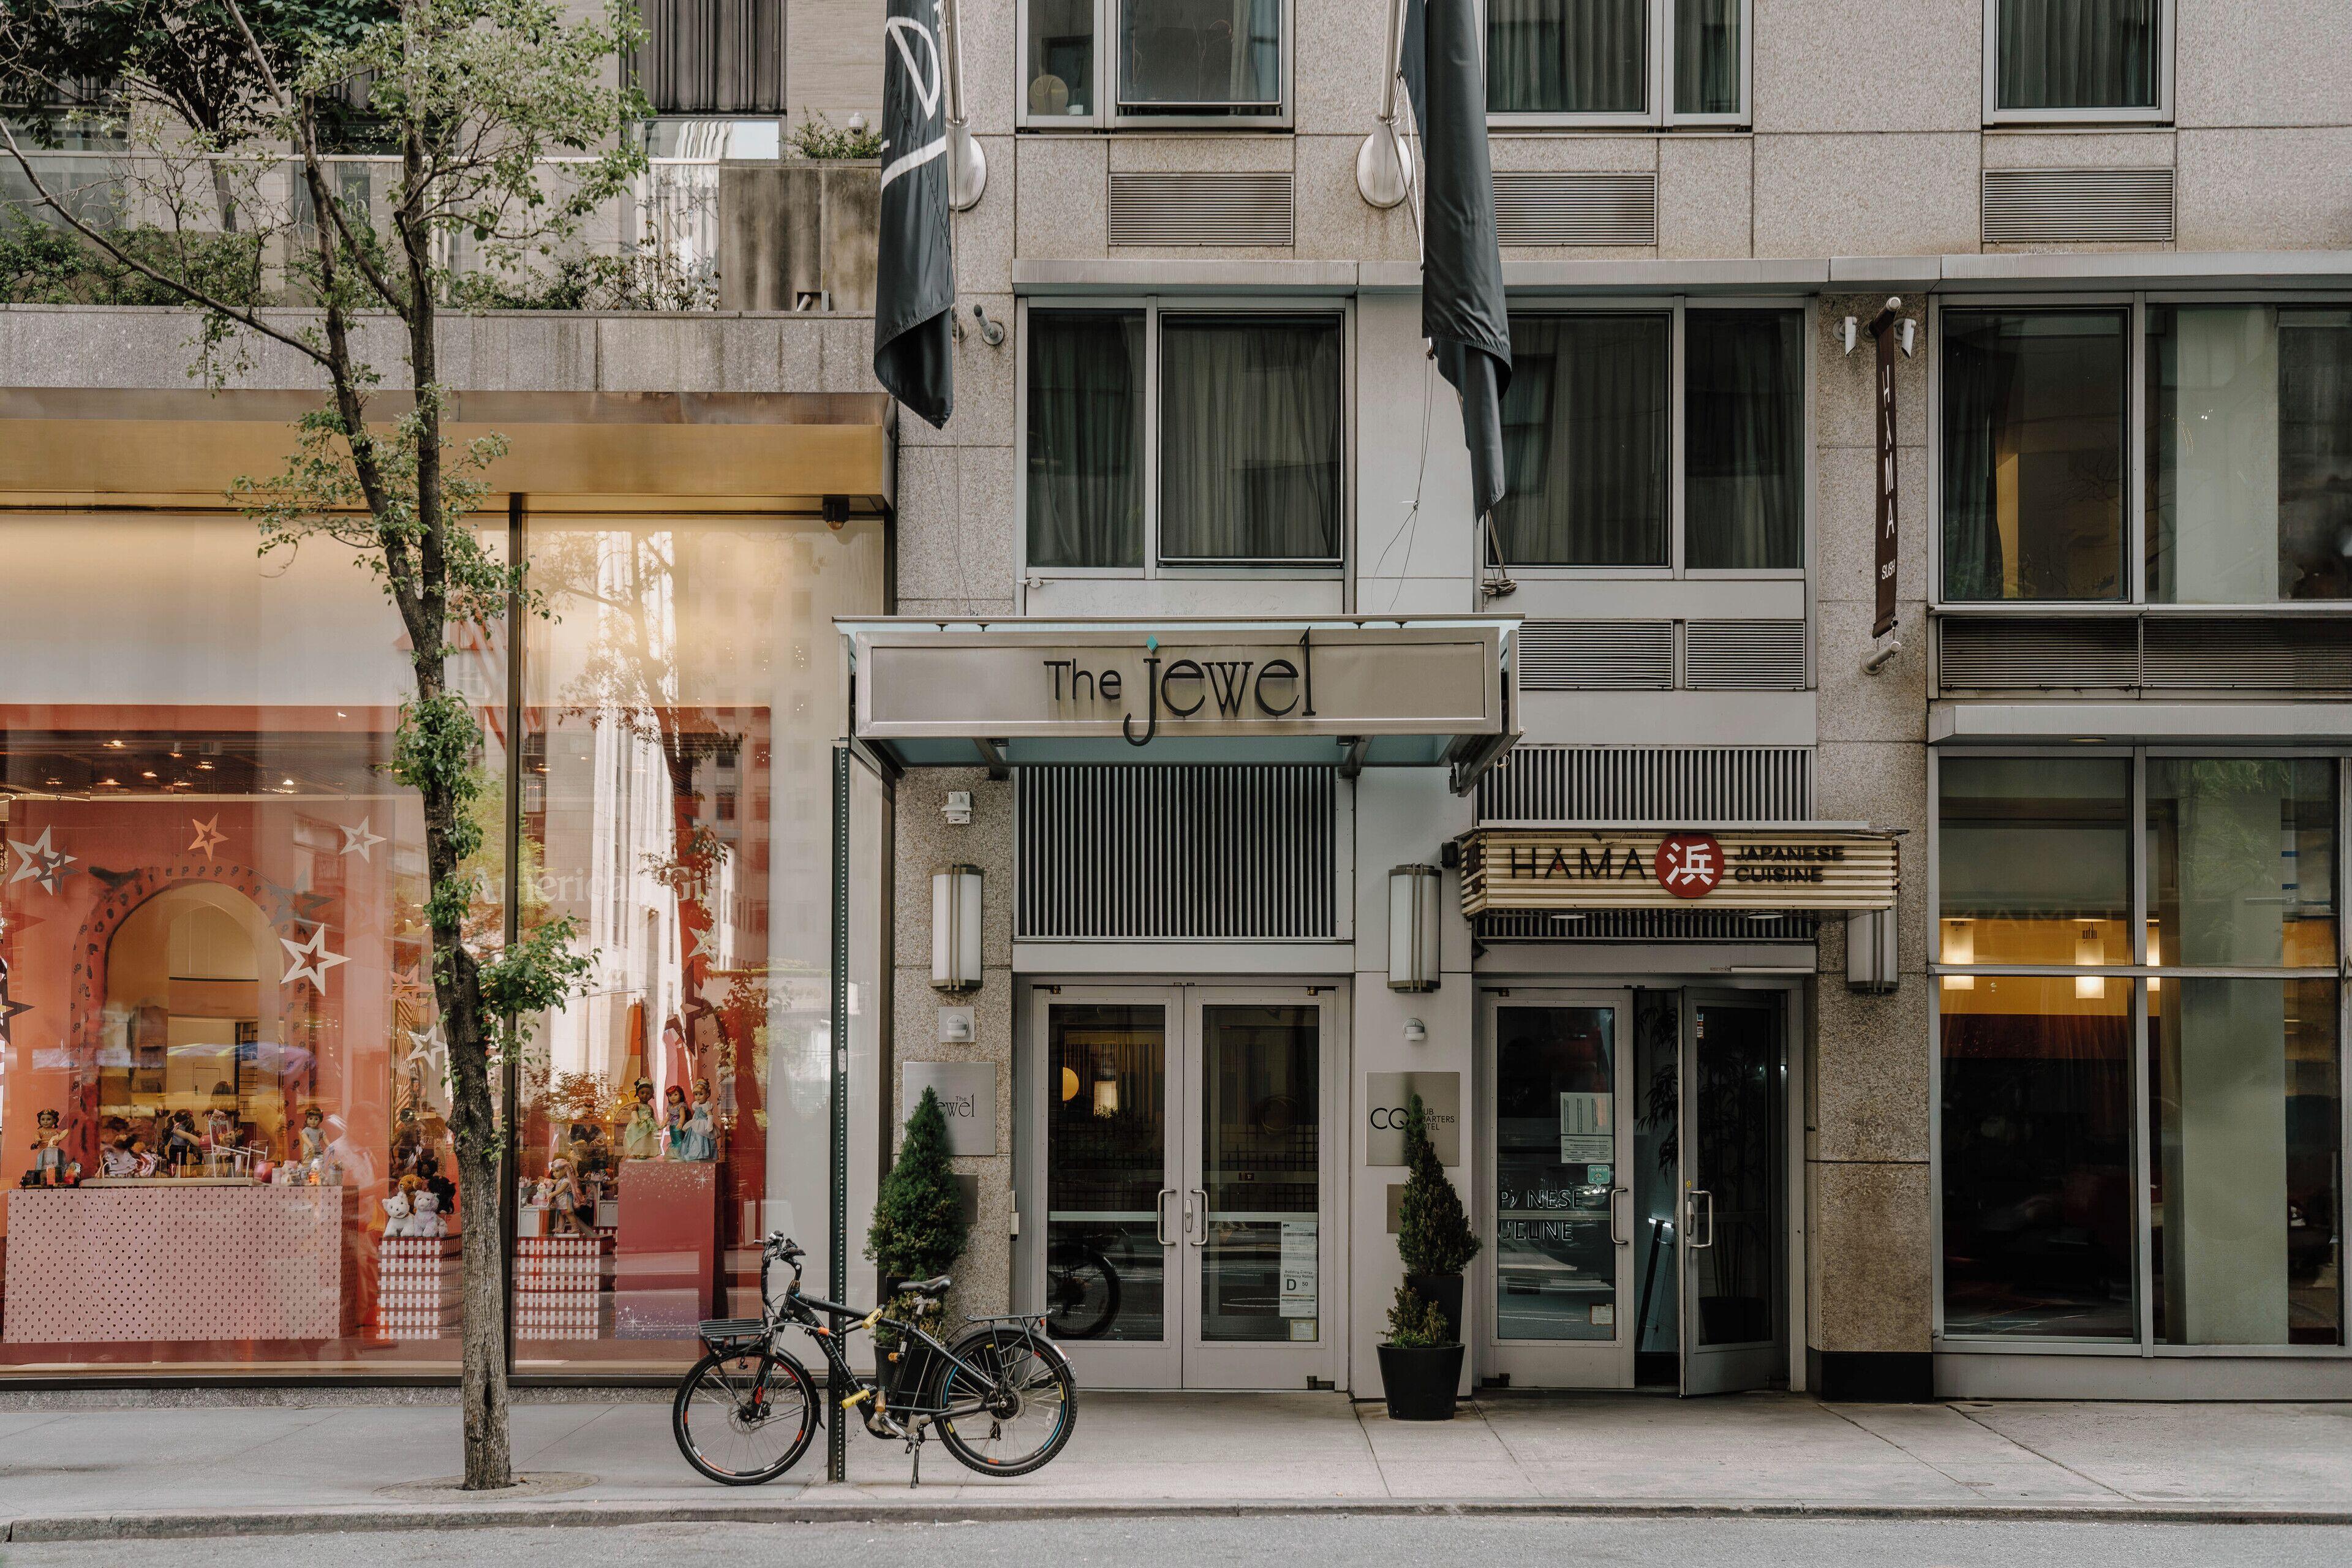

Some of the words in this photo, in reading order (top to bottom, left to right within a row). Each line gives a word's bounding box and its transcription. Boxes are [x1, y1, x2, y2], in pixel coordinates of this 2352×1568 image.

[1043, 658, 1121, 702] The
[1122, 625, 1316, 747] jewel
[1511, 847, 1647, 880] HAMA
[1666, 842, 1714, 886] 浜
[1734, 845, 1845, 861] JAPANESE
[1735, 867, 1823, 882] CUISINE
[935, 1093, 975, 1117] ewel
[1286, 1278, 1297, 1291] D
